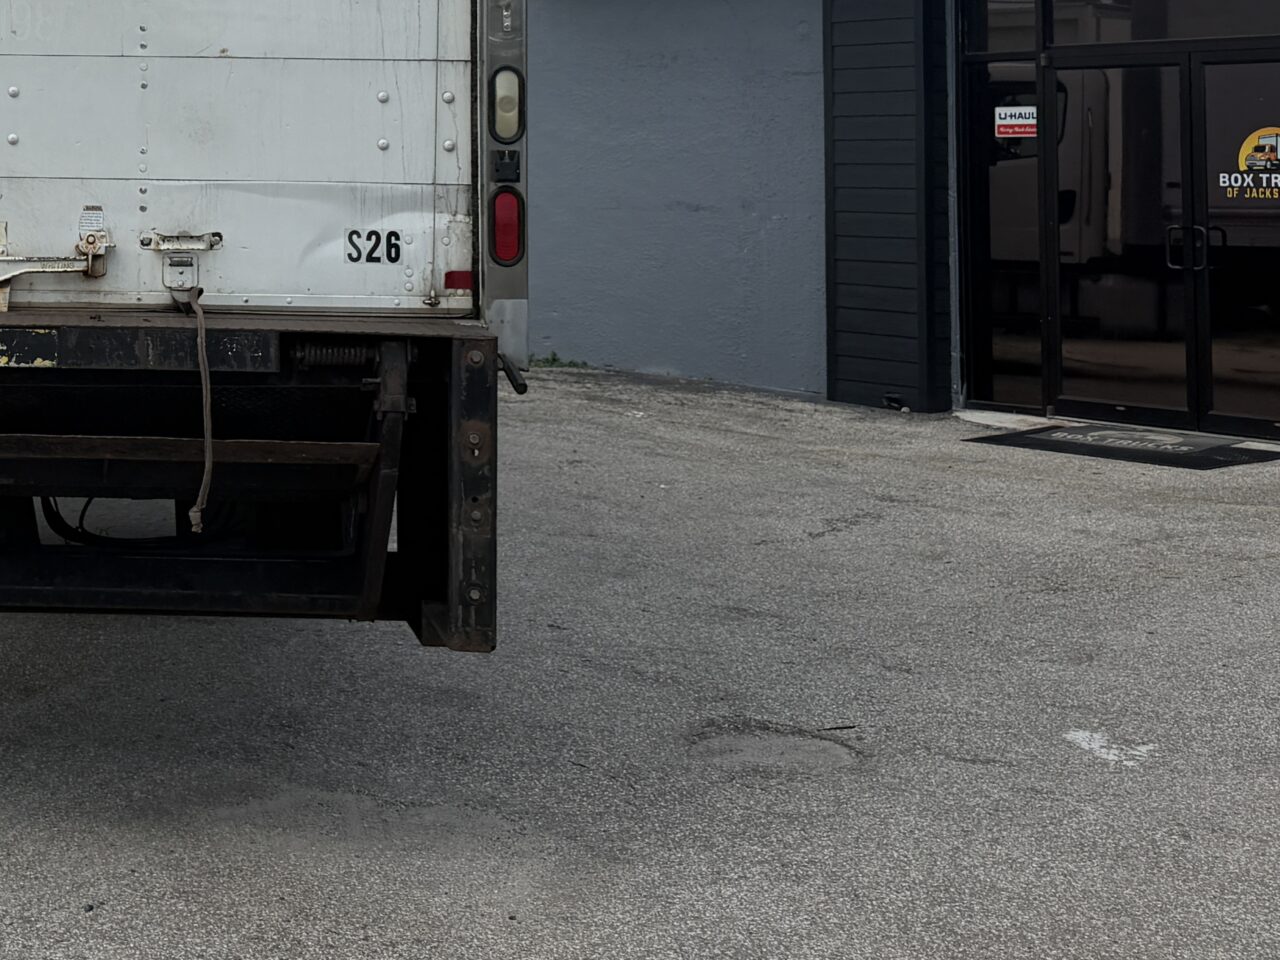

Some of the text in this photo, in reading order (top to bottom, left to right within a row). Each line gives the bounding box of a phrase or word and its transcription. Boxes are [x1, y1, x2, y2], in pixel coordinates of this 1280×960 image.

[1219, 172, 1280, 187] BOX TR
[1226, 187, 1280, 199] OF JACKS
[347, 229, 401, 264] S26
